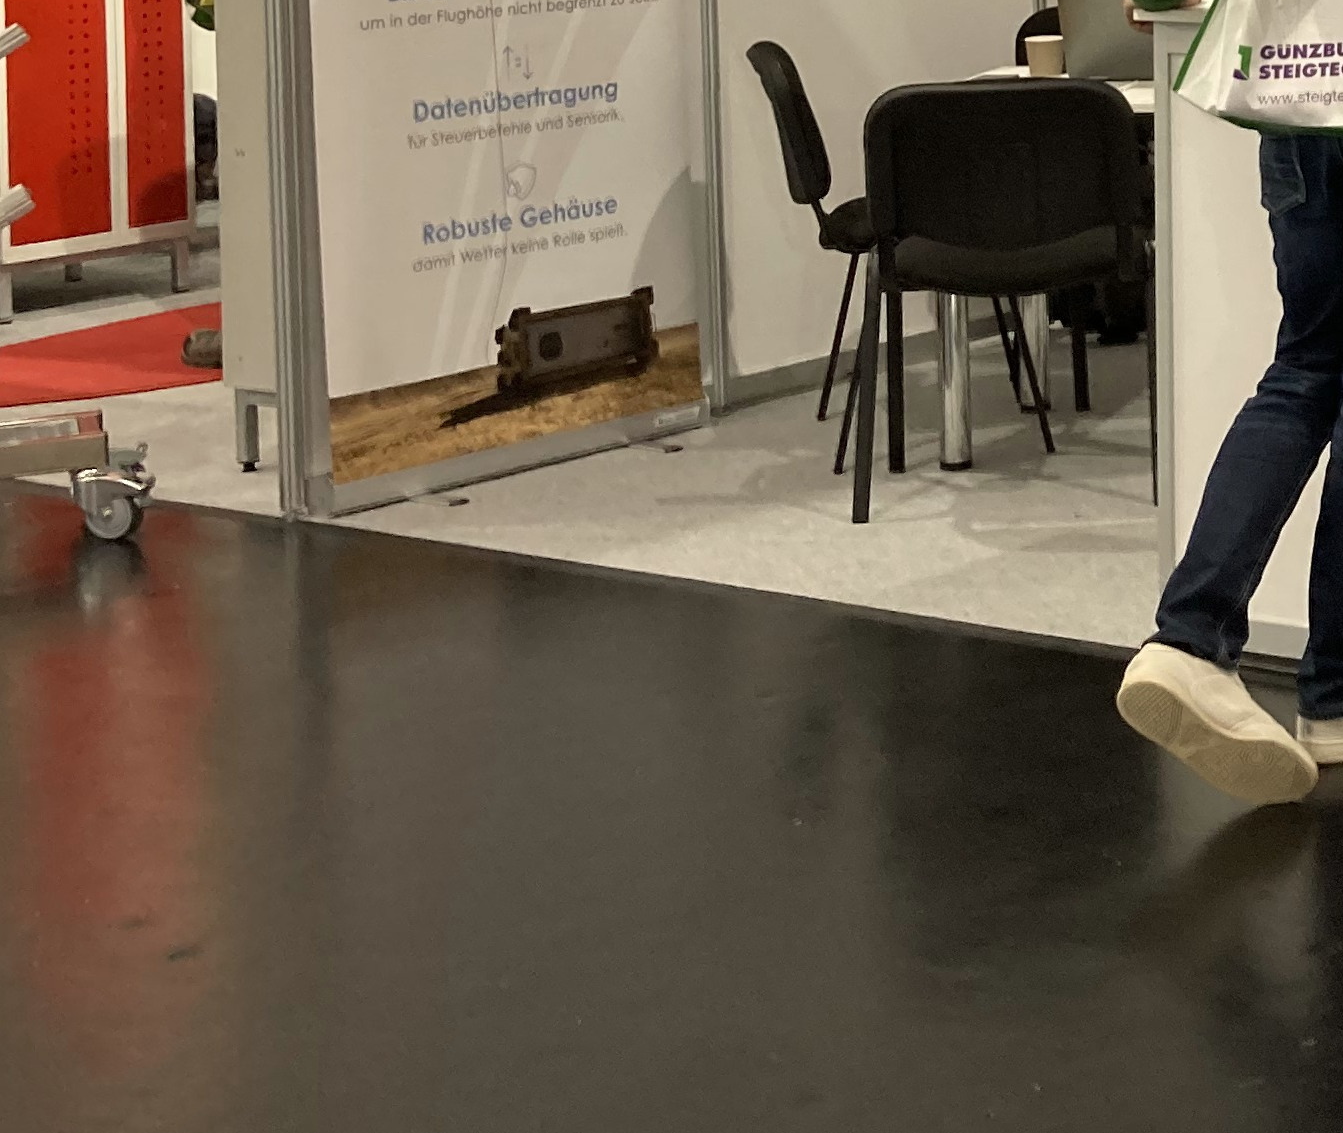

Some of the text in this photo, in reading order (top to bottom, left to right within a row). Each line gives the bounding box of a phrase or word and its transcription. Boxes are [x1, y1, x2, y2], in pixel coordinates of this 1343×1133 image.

[360, 17, 386, 31] um
[389, 14, 403, 28] in
[407, 12, 432, 27] der
[437, 5, 503, 24] Flughöhe
[508, 1, 543, 16] nicht
[413, 82, 618, 123] Datenübertragung
[408, 133, 429, 150] für
[431, 122, 531, 146] Steuerbefehle
[536, 117, 564, 132] und
[423, 197, 618, 244] Robuste Gehäuse
[412, 251, 456, 273] damit
[460, 245, 507, 264] Wetter
[512, 237, 549, 255] keine
[553, 229, 585, 248] Rolle
